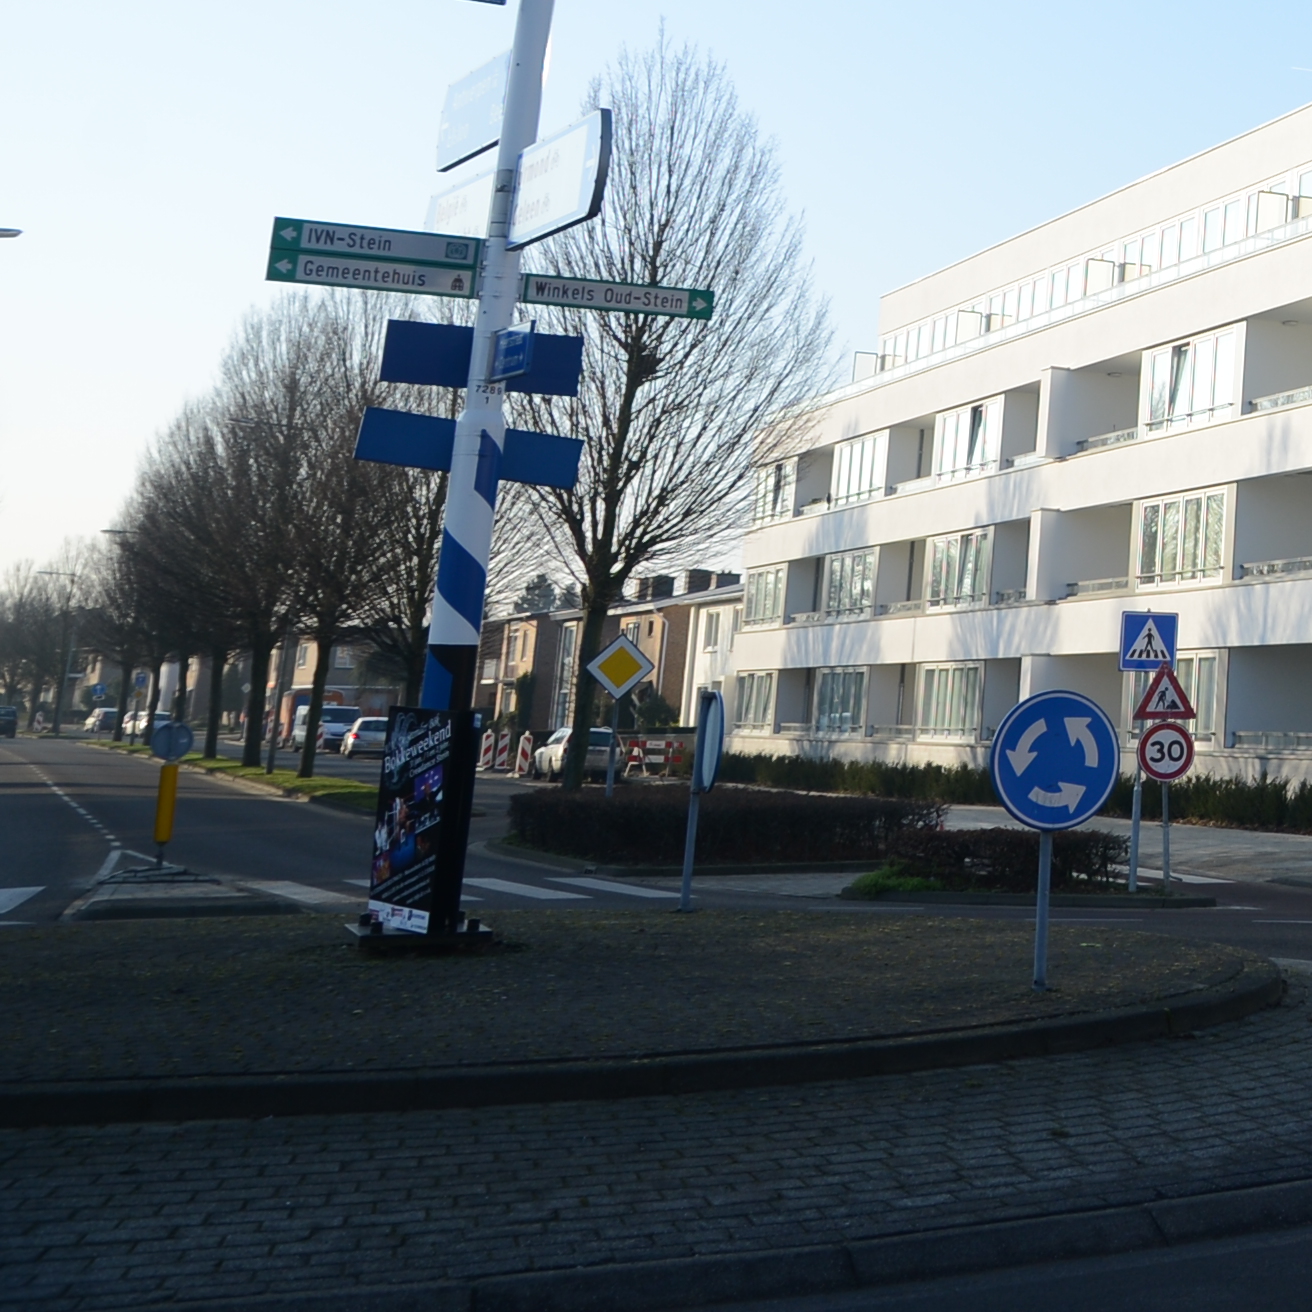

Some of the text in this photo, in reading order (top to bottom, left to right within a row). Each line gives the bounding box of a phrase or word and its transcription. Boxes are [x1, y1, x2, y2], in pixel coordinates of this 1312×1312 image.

[307, 227, 392, 252] IVN-Stein
[303, 260, 427, 287] Gemeentehuis
[535, 280, 683, 310] Winkels Oud-Stein
[384, 719, 452, 774] Bokkeweekend
[1149, 739, 1184, 762] 30
